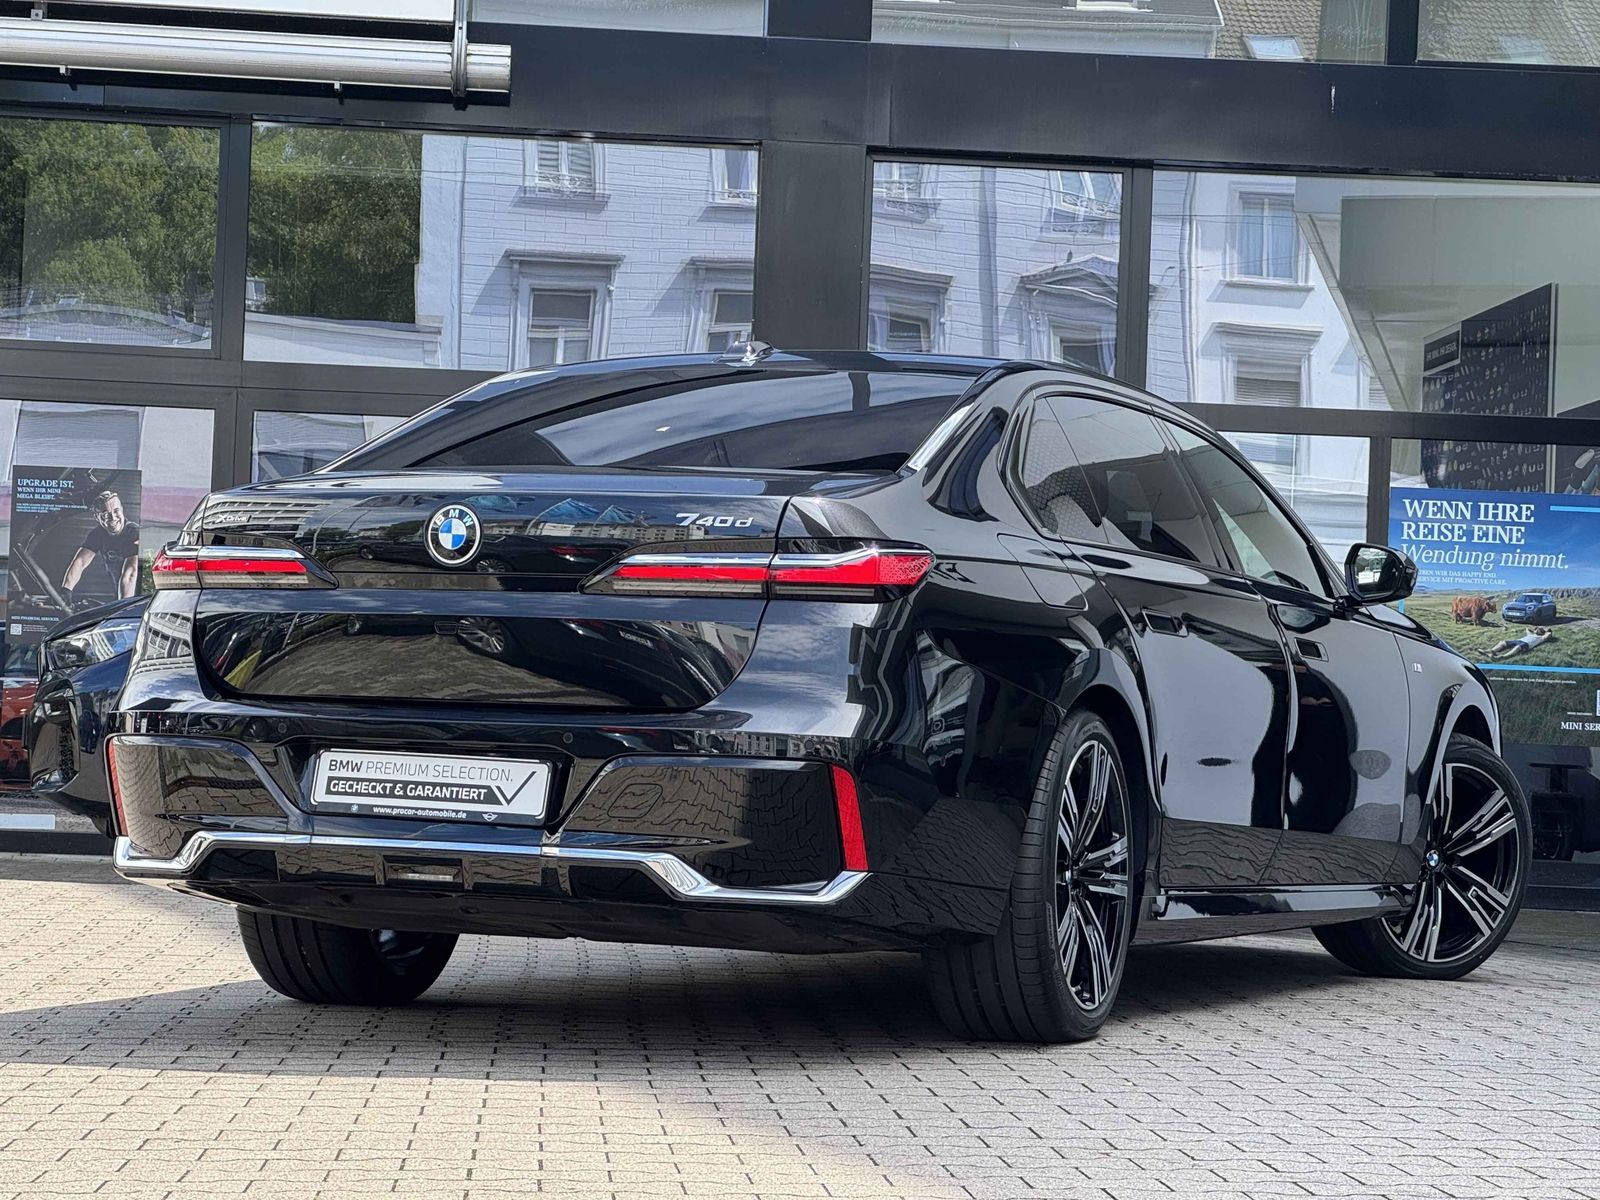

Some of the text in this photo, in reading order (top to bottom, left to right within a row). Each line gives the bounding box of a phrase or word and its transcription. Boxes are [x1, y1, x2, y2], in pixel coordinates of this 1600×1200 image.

[17, 478, 75, 489] UPGRADE IST.
[435, 508, 474, 527] BMW
[676, 512, 754, 527] 740d
[1402, 498, 1535, 523] WENN IHRE
[1401, 521, 1525, 545] REISE EINE
[1401, 543, 1569, 572] Wendung nimmt.
[1560, 721, 1582, 731] MINI
[328, 758, 513, 782] BMW PREMIUM SELECTION.
[329, 779, 488, 801] GECHECKT & GARANTIERT
[373, 806, 467, 819] www.procar-automobile.de
